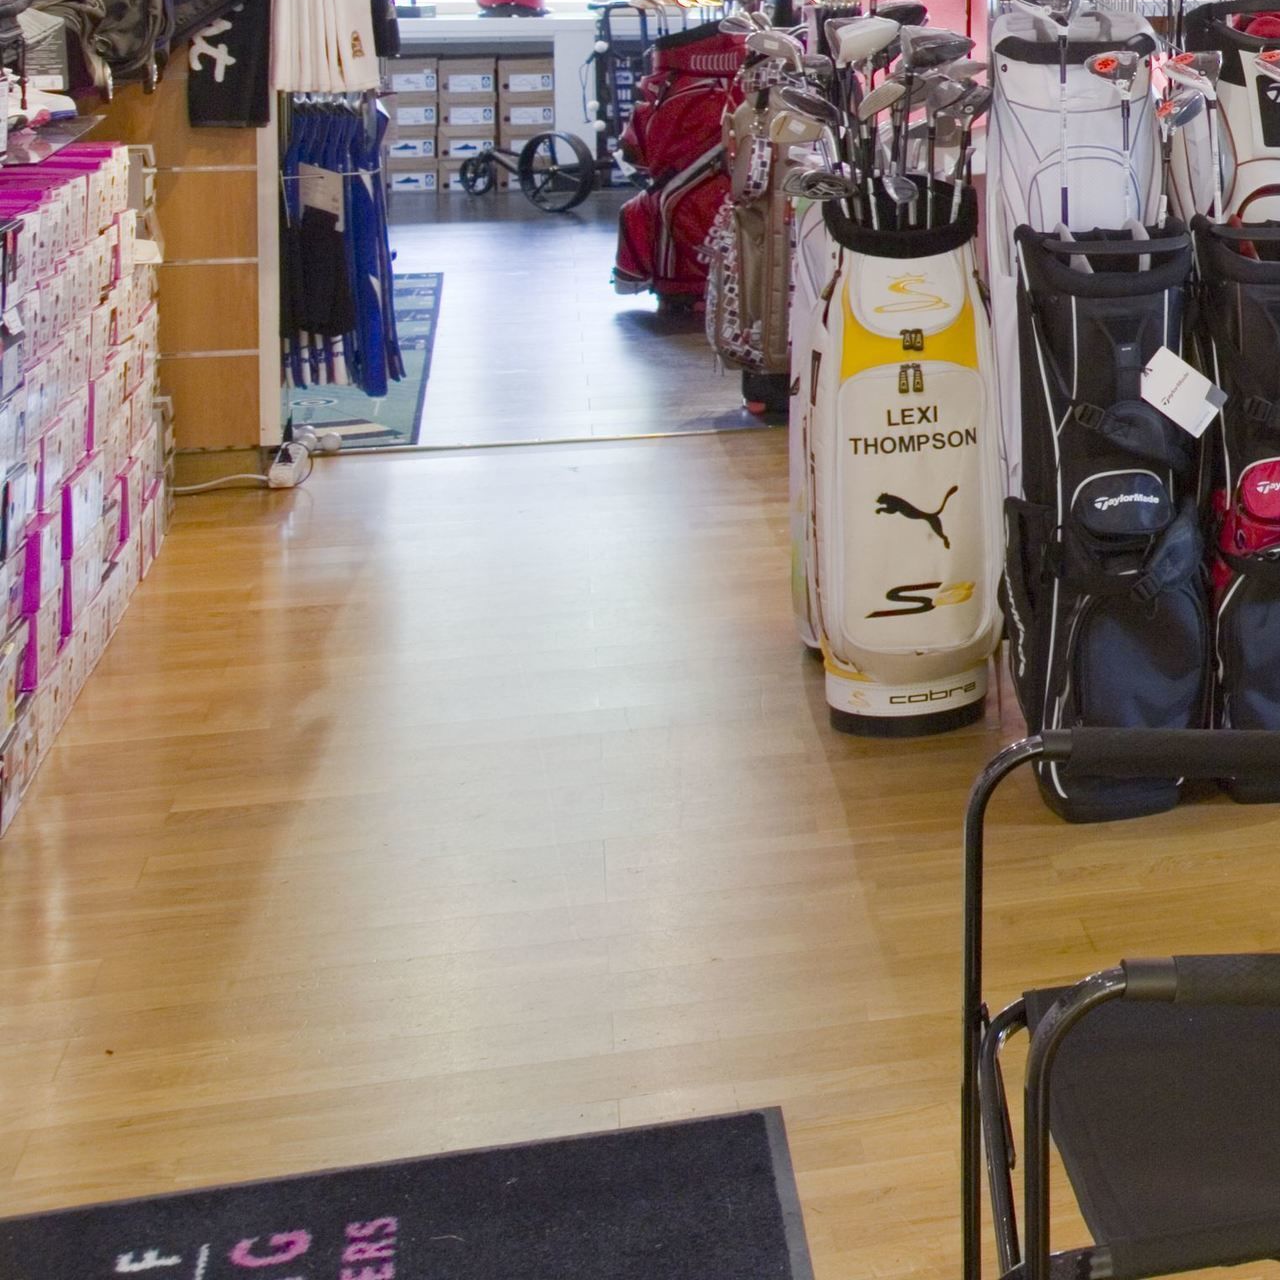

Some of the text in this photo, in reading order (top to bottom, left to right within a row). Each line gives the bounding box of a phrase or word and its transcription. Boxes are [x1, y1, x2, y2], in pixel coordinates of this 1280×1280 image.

[886, 406, 938, 428] LEXI
[849, 426, 977, 456] THOMPSON
[1093, 493, 1160, 511] TaylorMade
[889, 680, 977, 705] cobra
[337, 1216, 399, 1280] ERS
